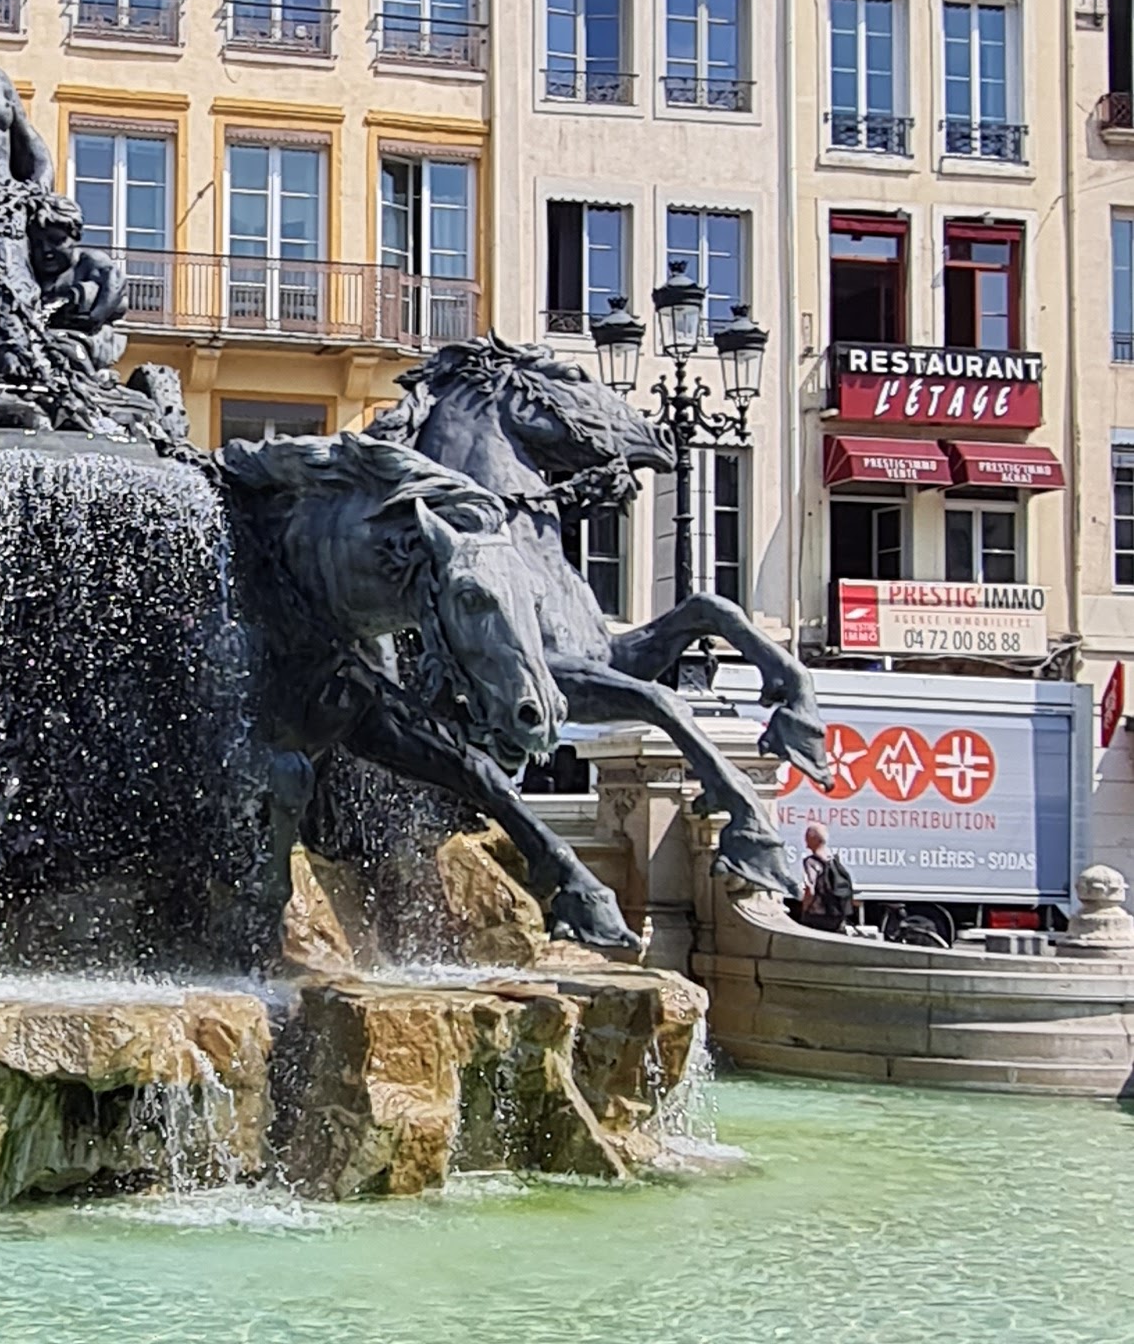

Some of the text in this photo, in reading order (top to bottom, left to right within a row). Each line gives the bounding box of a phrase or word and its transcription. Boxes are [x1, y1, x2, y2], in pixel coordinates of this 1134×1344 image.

[849, 348, 1041, 381] RESTAURANT
[874, 378, 1011, 421] L'ÉTAGE
[889, 584, 1045, 611] PRESTIG'IMMO
[894, 614, 940, 626] AGENCE
[844, 631, 878, 642] IMMO
[904, 629, 1021, 652] 04 72 00 88 88
[777, 806, 996, 831] NE-ALPES DISTRIBUTION
[831, 846, 1036, 871] RITUEUX BIÈRES SODAS
